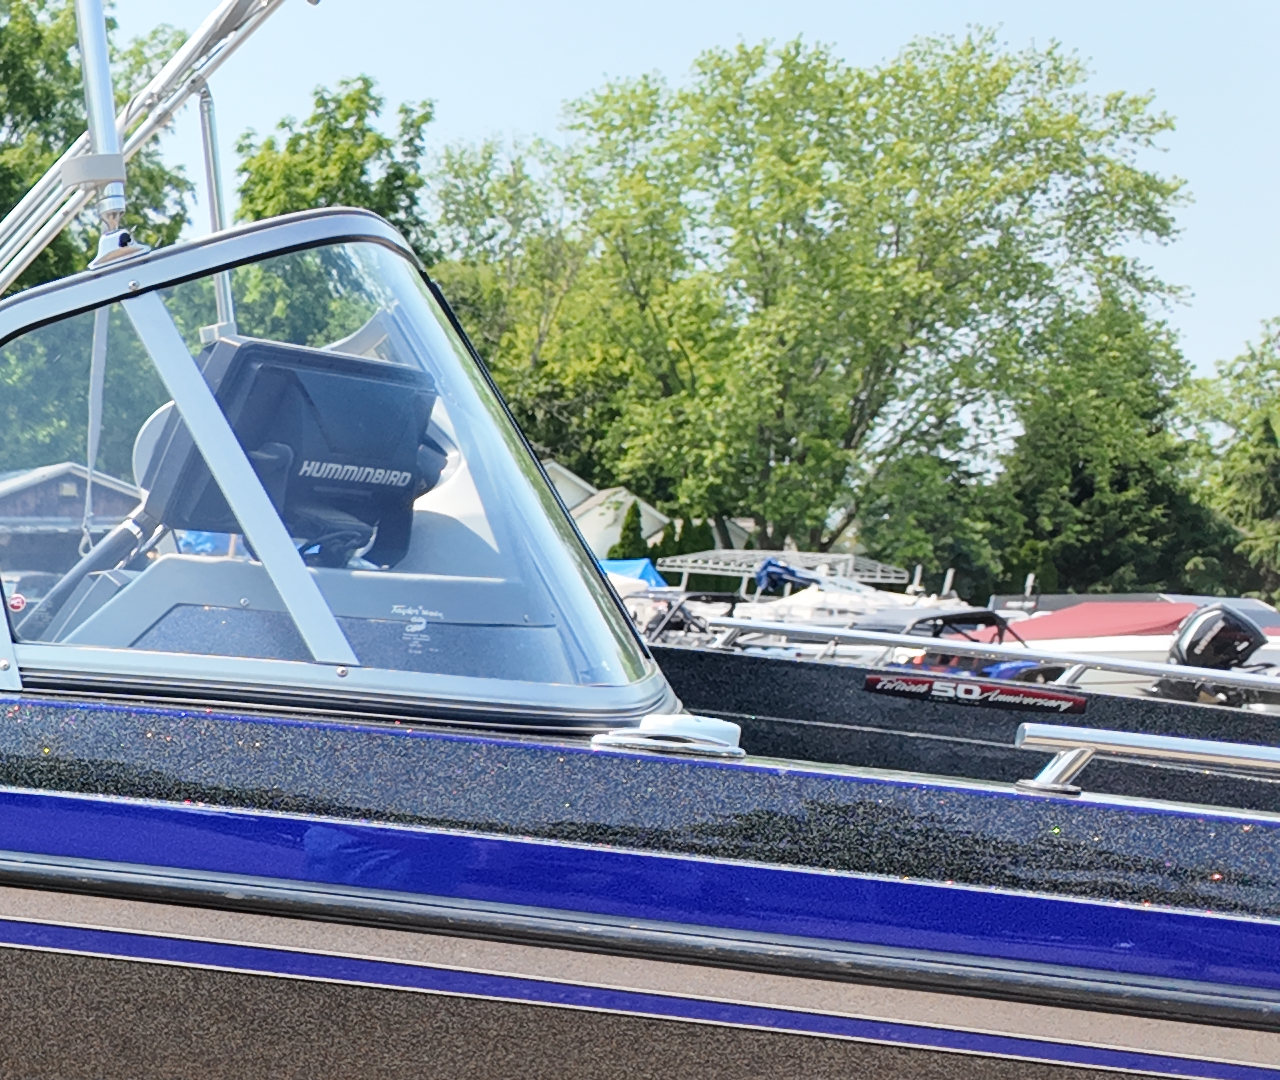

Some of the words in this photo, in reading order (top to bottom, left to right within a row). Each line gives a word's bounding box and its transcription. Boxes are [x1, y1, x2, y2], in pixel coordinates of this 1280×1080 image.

[298, 460, 412, 487] HUMMINBIRD
[931, 681, 981, 700] 50
[980, 689, 1074, 711] Anniversary
